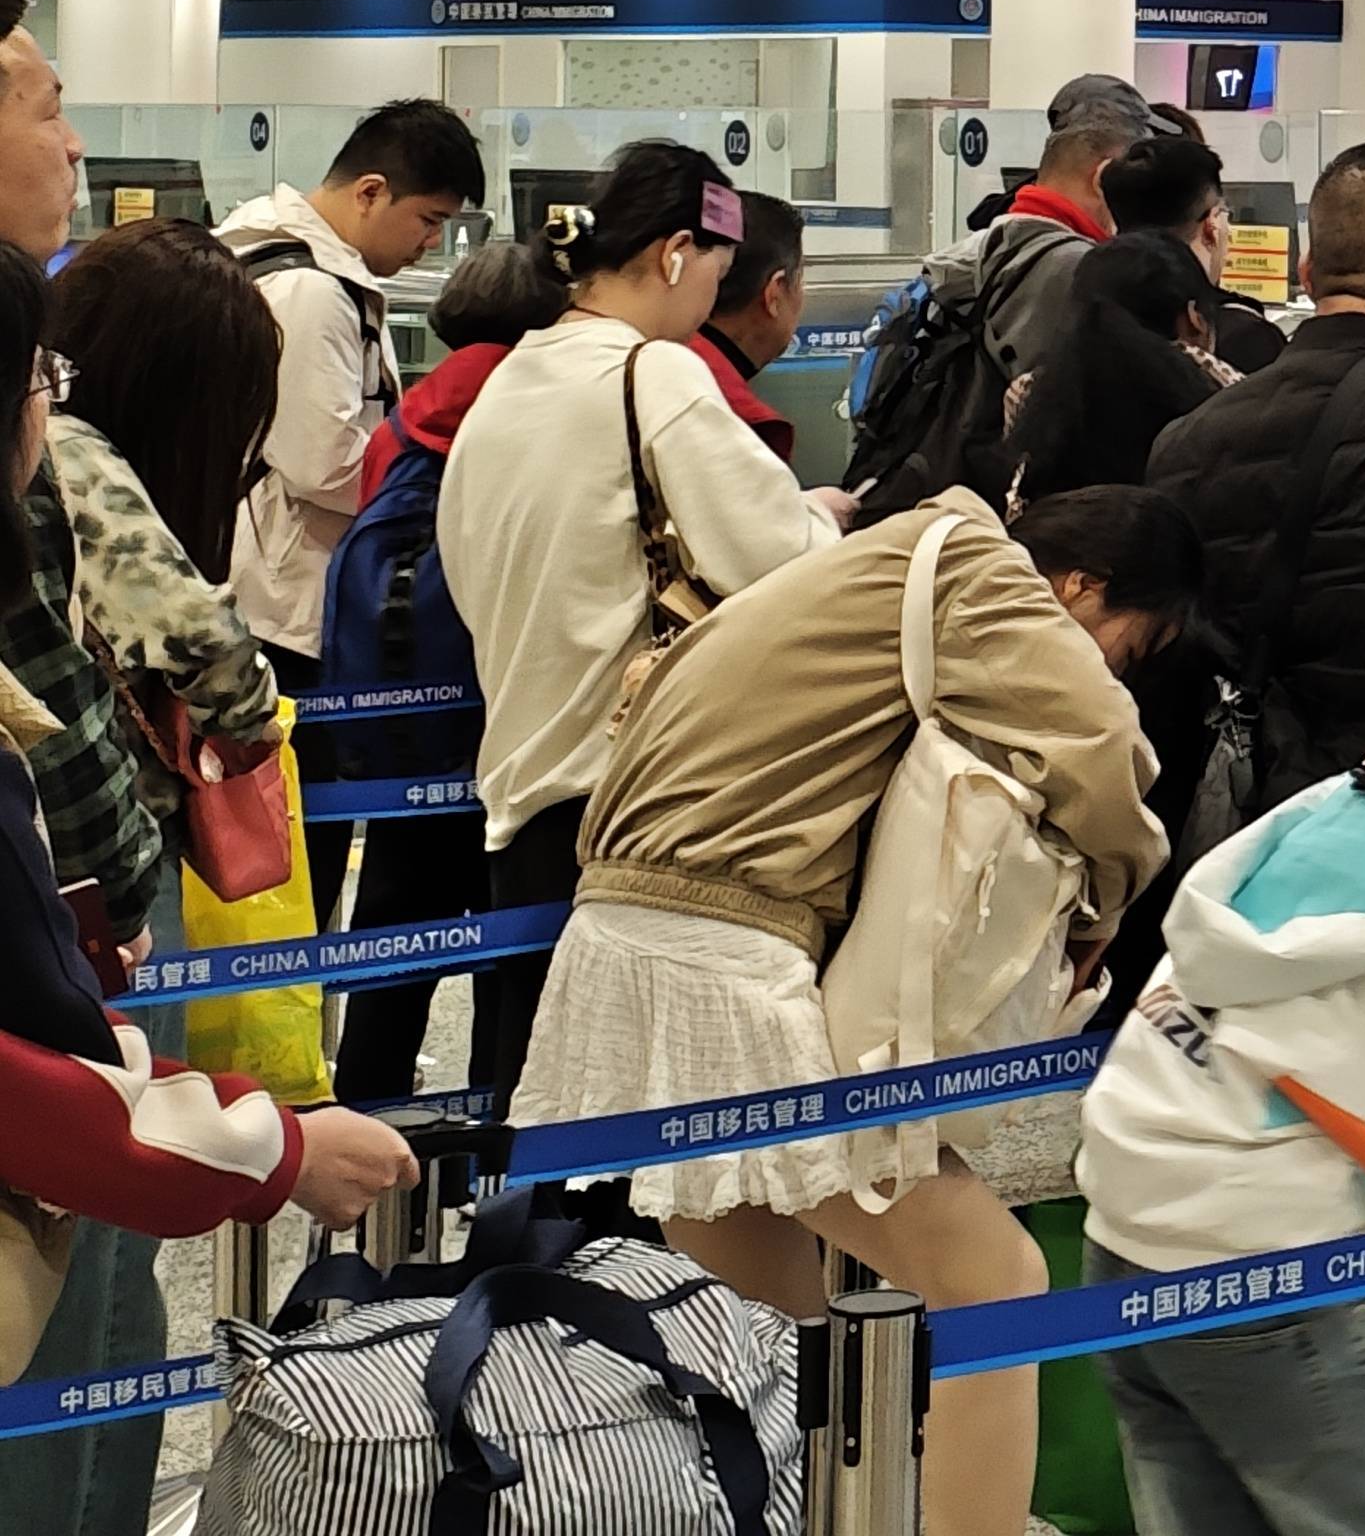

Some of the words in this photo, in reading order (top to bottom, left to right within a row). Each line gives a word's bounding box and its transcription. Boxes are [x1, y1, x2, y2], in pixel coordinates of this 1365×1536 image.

[1170, 9, 1268, 25] IMMIGRATION
[728, 131, 746, 154] 02
[964, 131, 984, 154] 01
[353, 685, 463, 709] IMMIGRATION
[231, 951, 309, 978] CHINA
[320, 924, 482, 967] IMMIGRATION
[660, 1094, 825, 1148] 中国移民管理
[844, 1079, 924, 1116] CHINA
[935, 1046, 1099, 1098] IMMIGRATION
[1121, 1259, 1305, 1327] 中国移民管理
